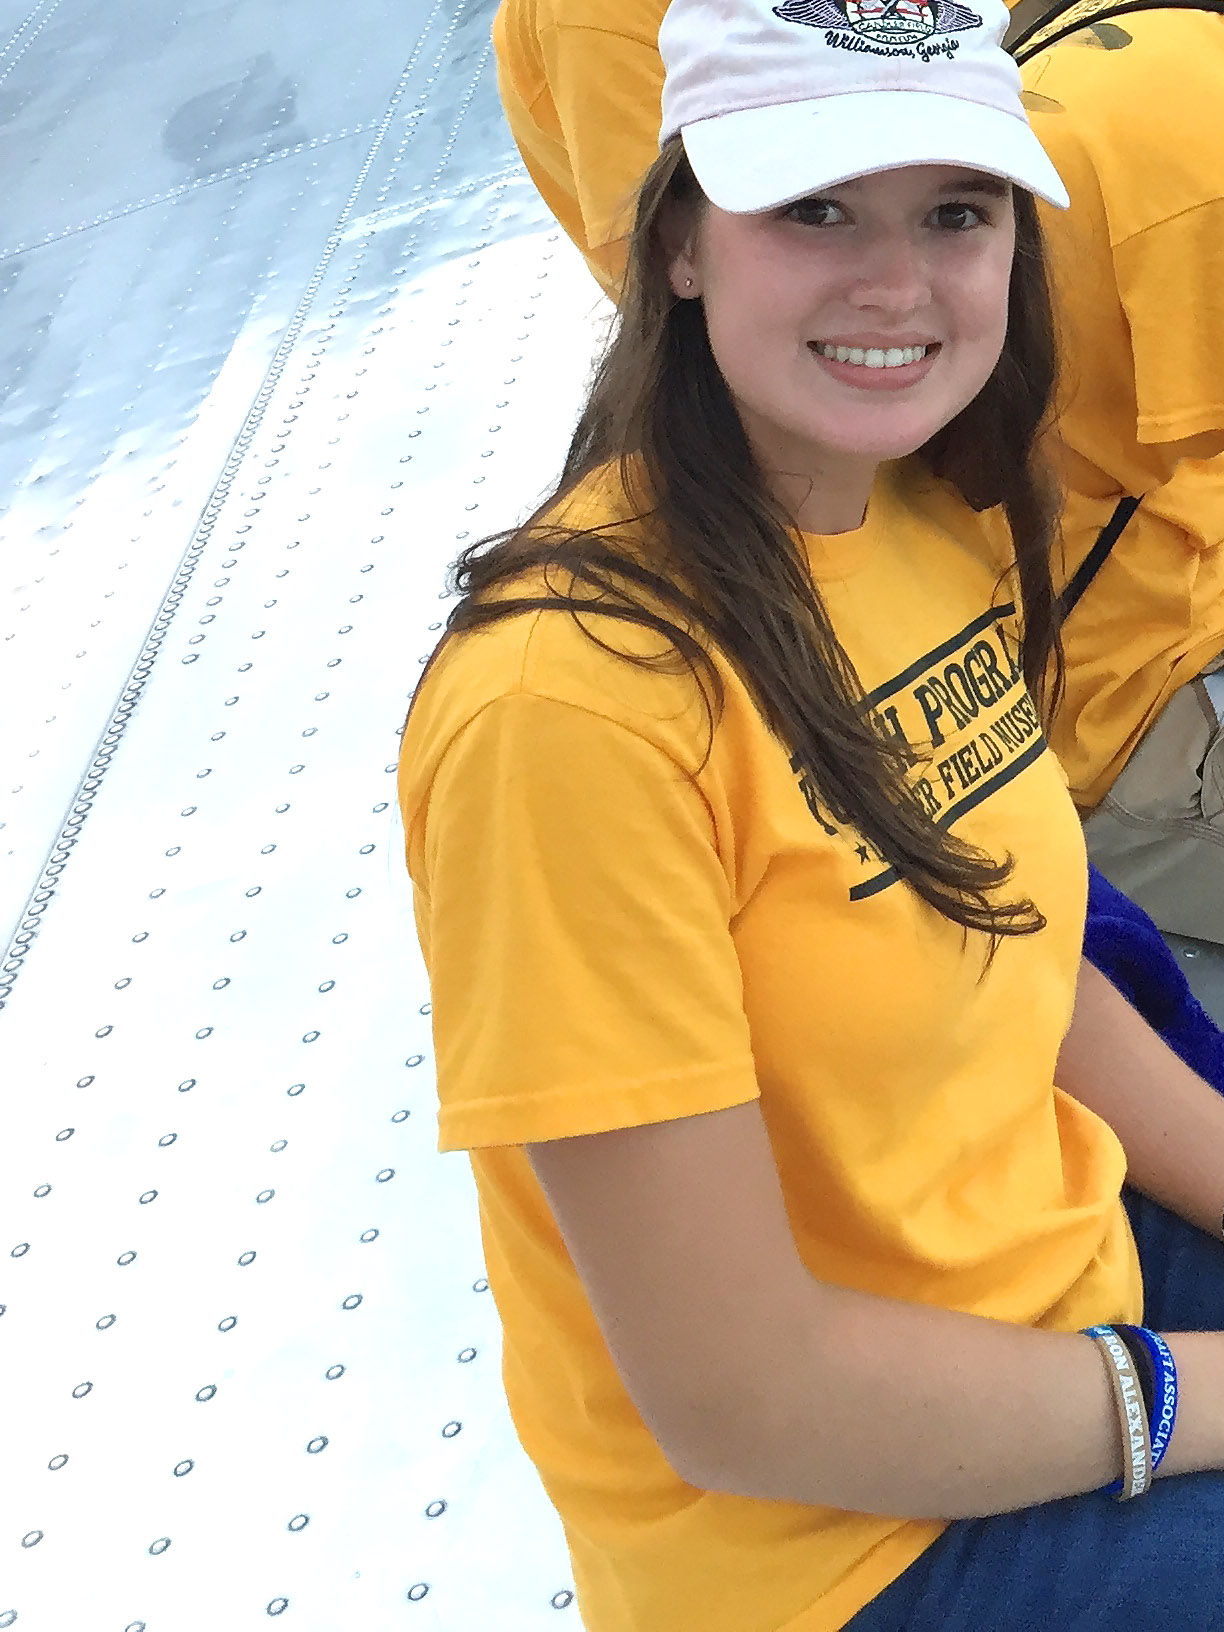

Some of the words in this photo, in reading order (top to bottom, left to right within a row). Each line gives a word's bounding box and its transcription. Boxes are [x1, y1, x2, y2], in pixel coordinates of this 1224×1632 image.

[913, 623, 1024, 750] PROGRA
[936, 732, 1004, 801] FIELD
[989, 692, 1042, 754] MUSE
[1150, 1371, 1176, 1467] ASSOCIAT
